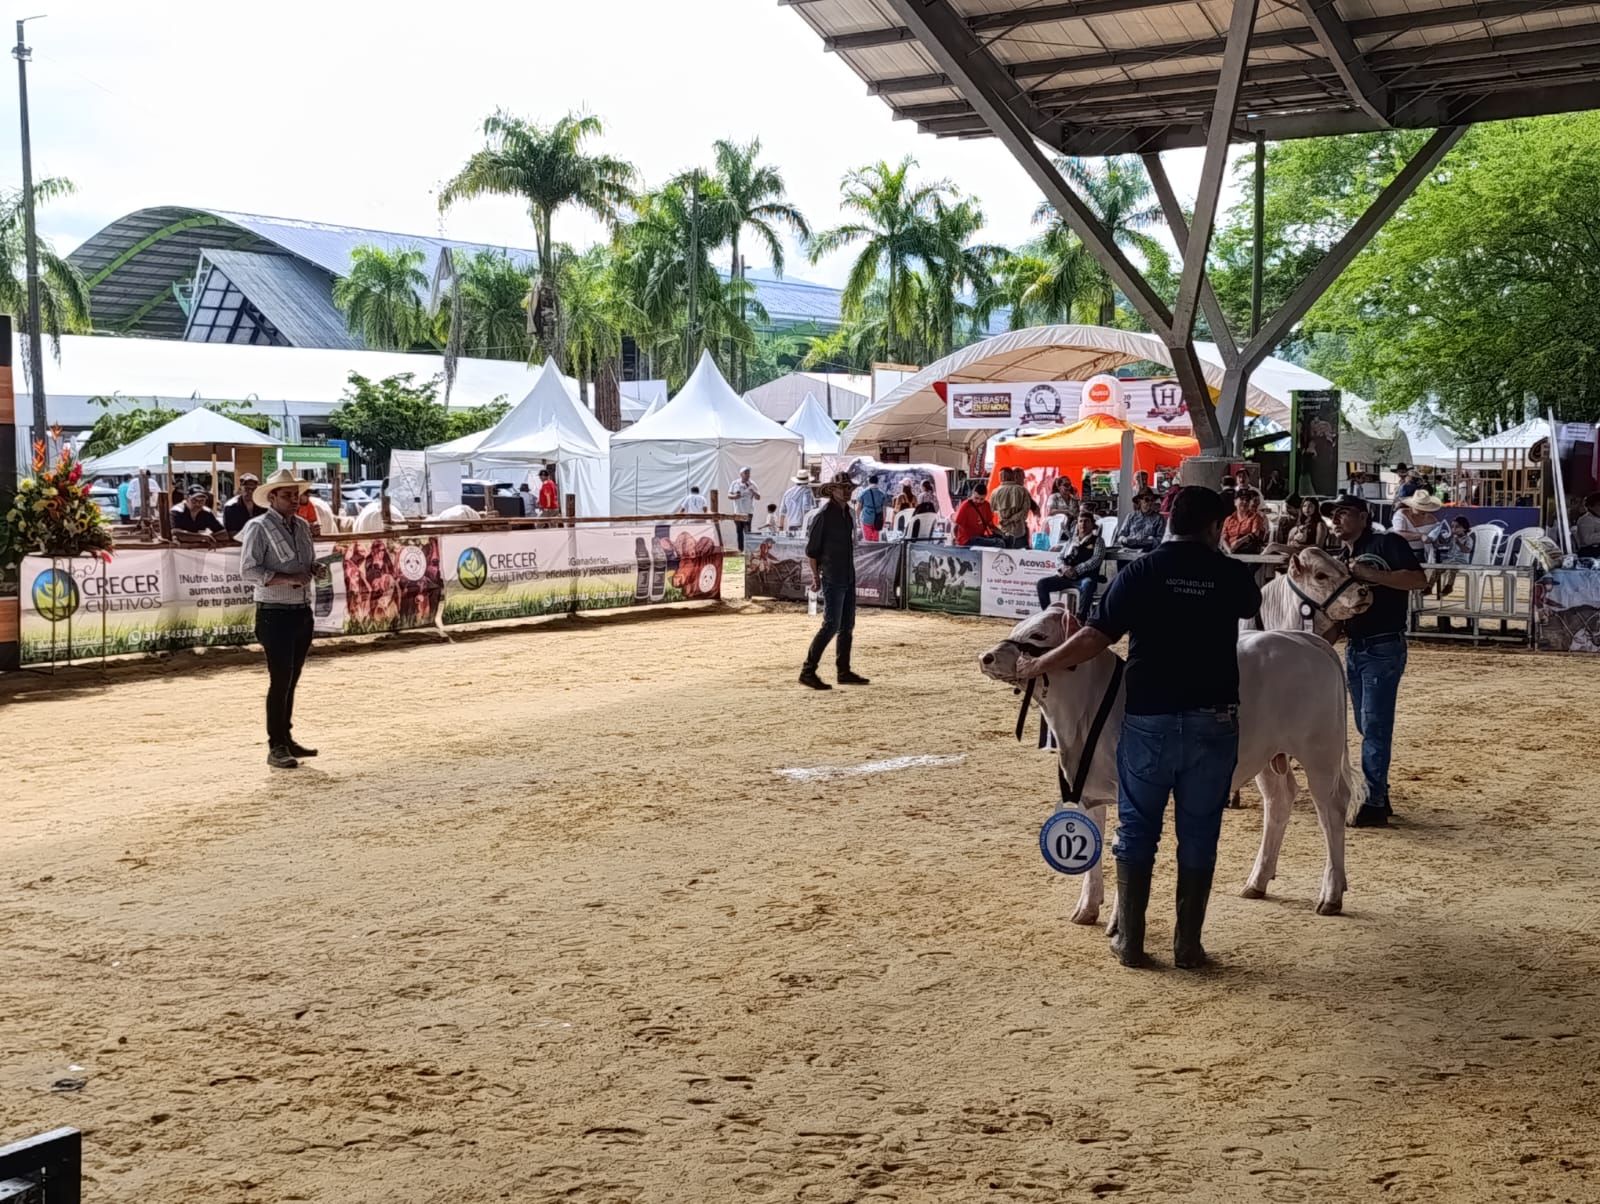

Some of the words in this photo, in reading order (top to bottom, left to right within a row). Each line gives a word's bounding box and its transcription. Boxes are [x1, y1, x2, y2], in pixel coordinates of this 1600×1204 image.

[973, 395, 1010, 404] SUBASTA
[488, 552, 537, 570] CRECER
[211, 573, 225, 583] las
[490, 570, 540, 584] CULTIVOS
[545, 568, 582, 580] eficientes
[82, 574, 160, 598] CRECER
[189, 584, 232, 597] aumenta
[233, 583, 243, 594] el
[85, 596, 163, 613] CULTIVOS
[197, 599, 210, 609] de
[211, 598, 222, 608] tu
[143, 630, 161, 644] 317
[212, 625, 229, 637] 312
[1056, 833, 1088, 861] 02
